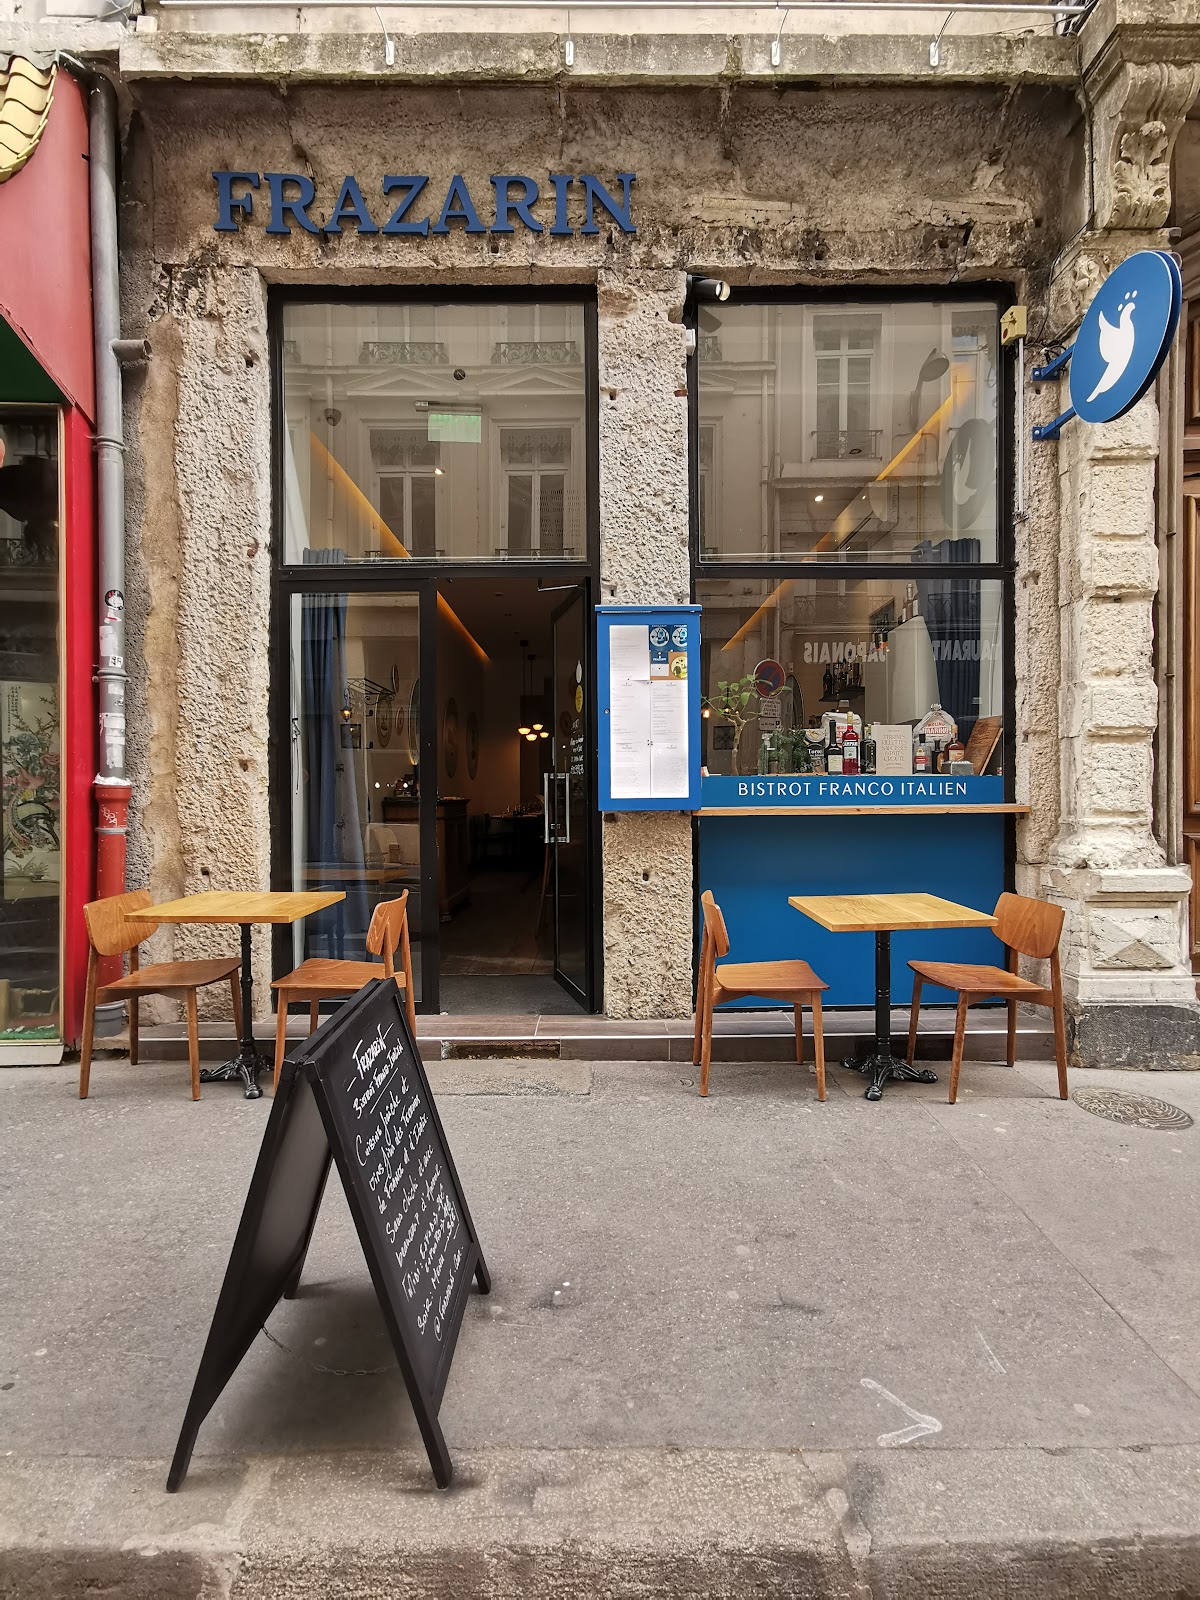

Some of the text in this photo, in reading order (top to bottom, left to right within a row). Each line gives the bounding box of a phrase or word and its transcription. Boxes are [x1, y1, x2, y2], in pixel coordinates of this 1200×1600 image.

[212, 171, 637, 236] FRAZARIN
[738, 782, 967, 796] BISTROT FRANCO ITALIEN
